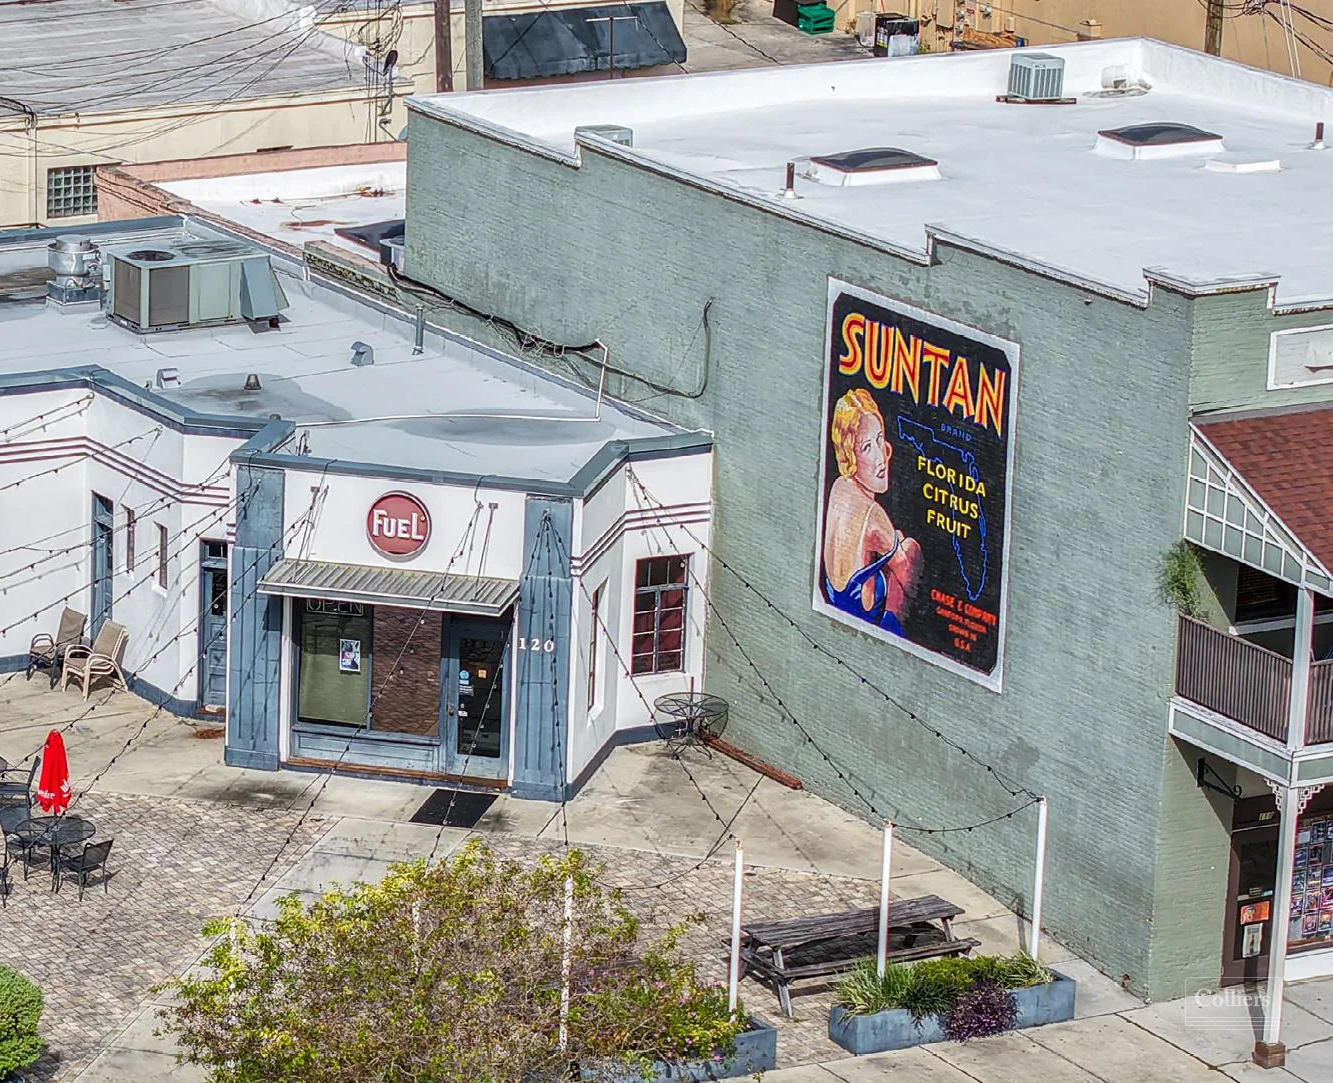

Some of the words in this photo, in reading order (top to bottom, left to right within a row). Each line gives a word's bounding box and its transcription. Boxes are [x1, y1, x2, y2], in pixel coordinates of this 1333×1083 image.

[839, 312, 1006, 440] SUNTAN
[940, 423, 972, 442] BRAND
[917, 455, 986, 498] FLORIDA
[922, 482, 979, 519] CITRUS
[372, 509, 425, 541] FUEL
[927, 509, 972, 539] FRUIT
[519, 637, 555, 652] 120
